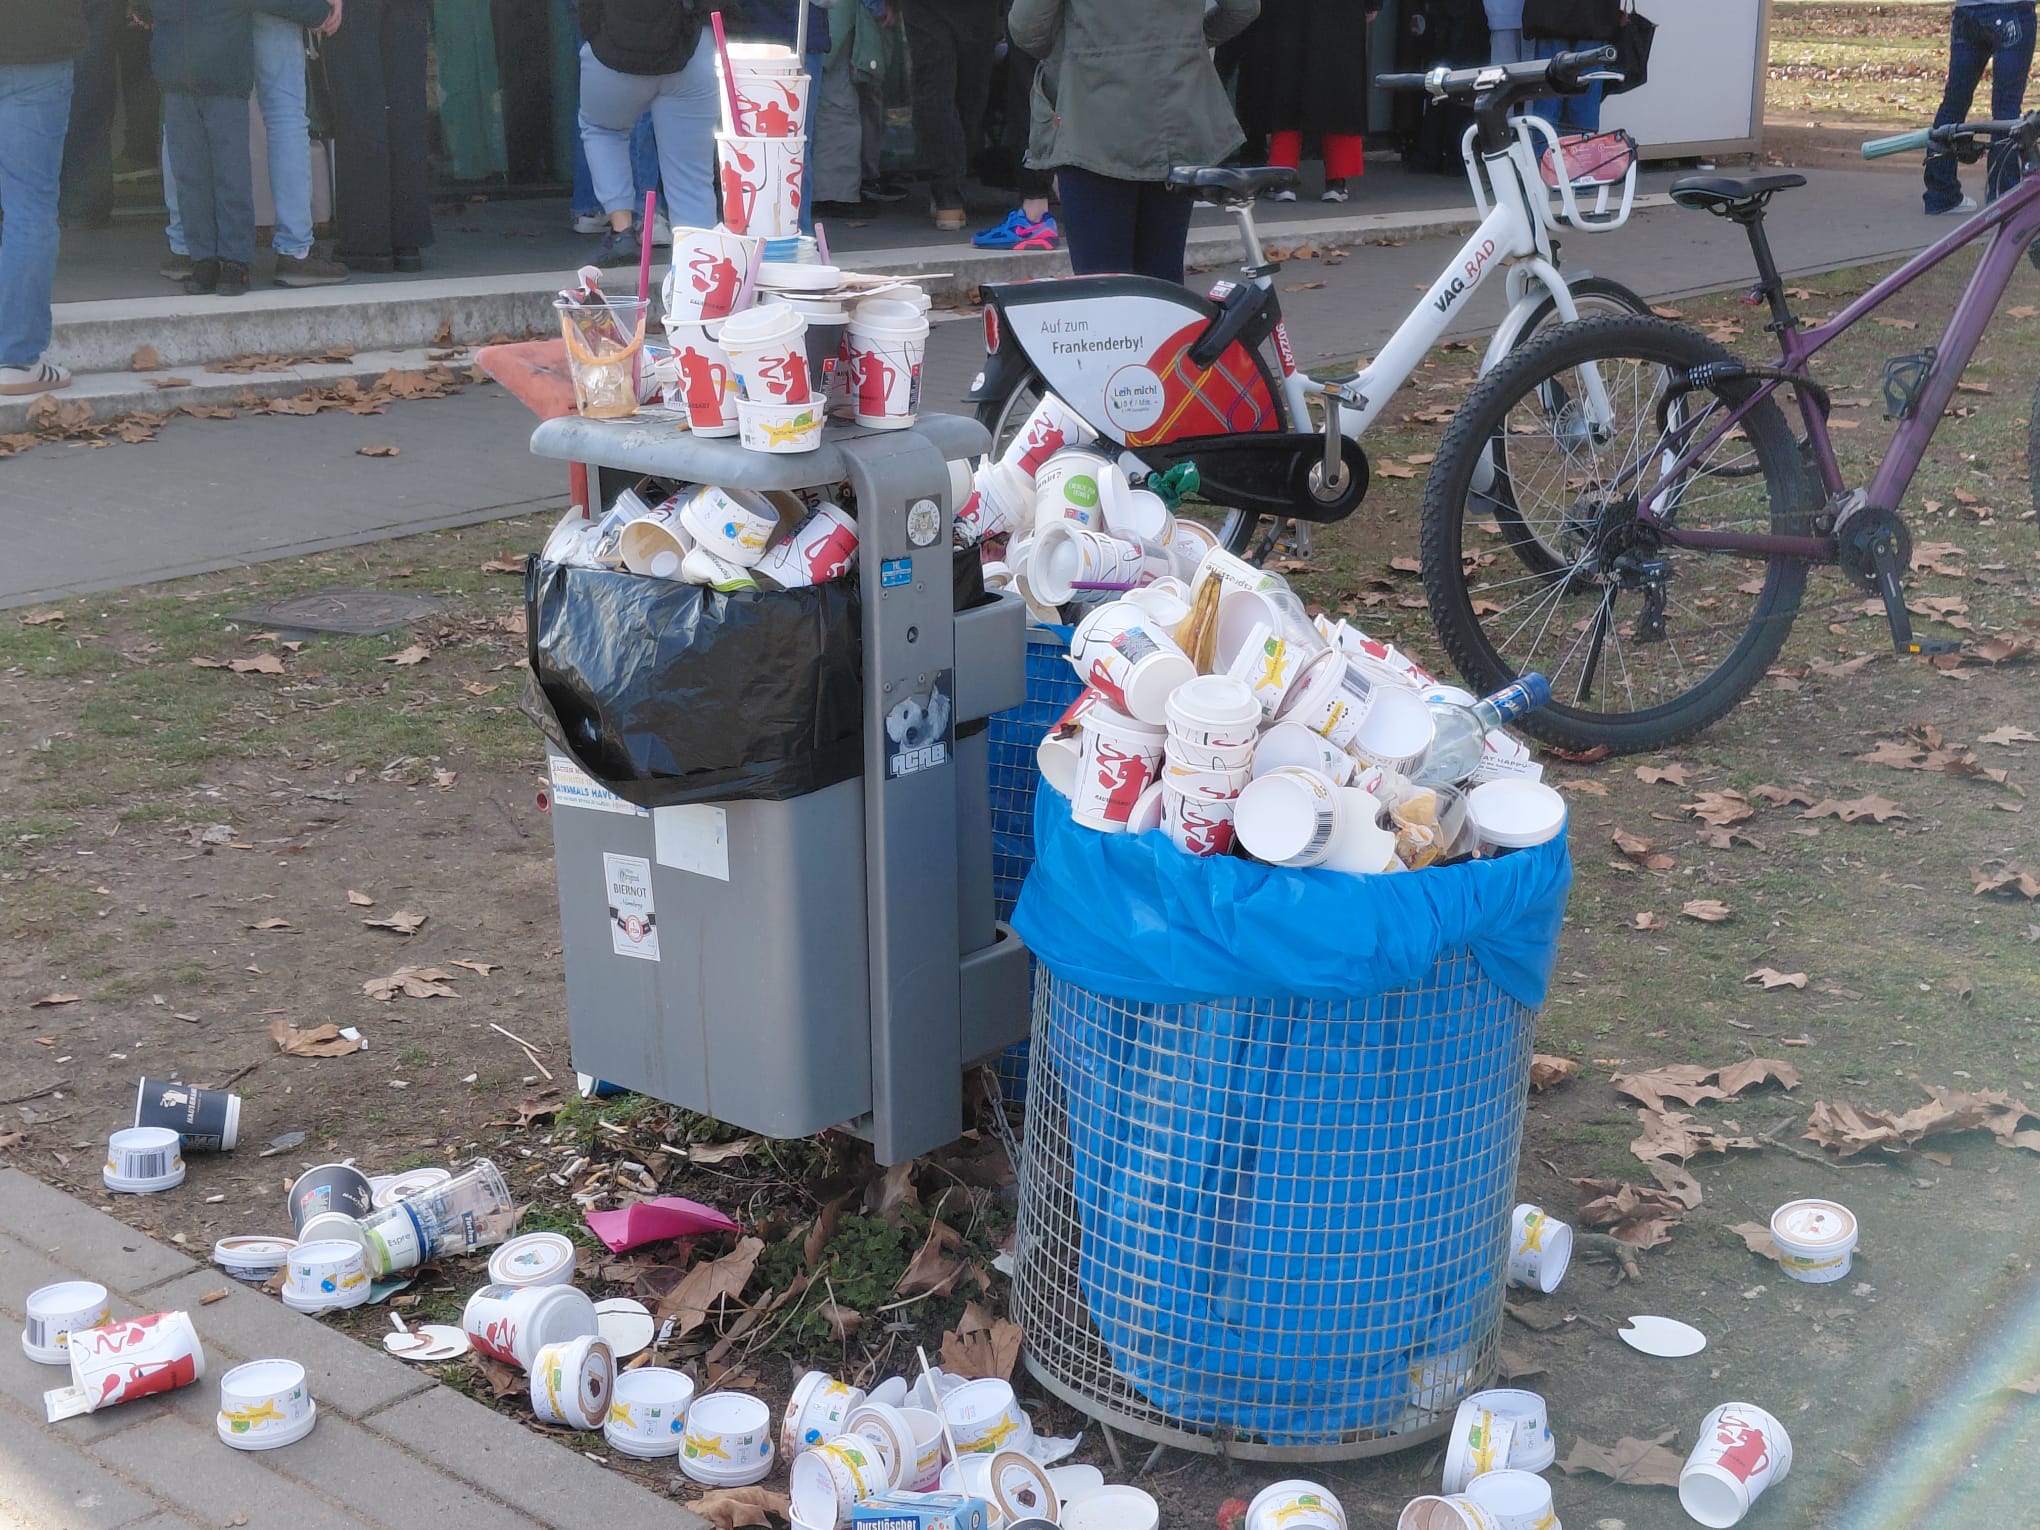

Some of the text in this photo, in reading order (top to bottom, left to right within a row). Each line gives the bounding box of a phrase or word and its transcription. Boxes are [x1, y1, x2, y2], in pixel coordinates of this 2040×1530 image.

[1433, 239, 1495, 313] VAG RAD
[1040, 319, 1089, 334] Auf zum
[1052, 335, 1144, 354] Frankenderby!
[889, 741, 948, 778] ACAB
[613, 882, 647, 899] BIERNOT
